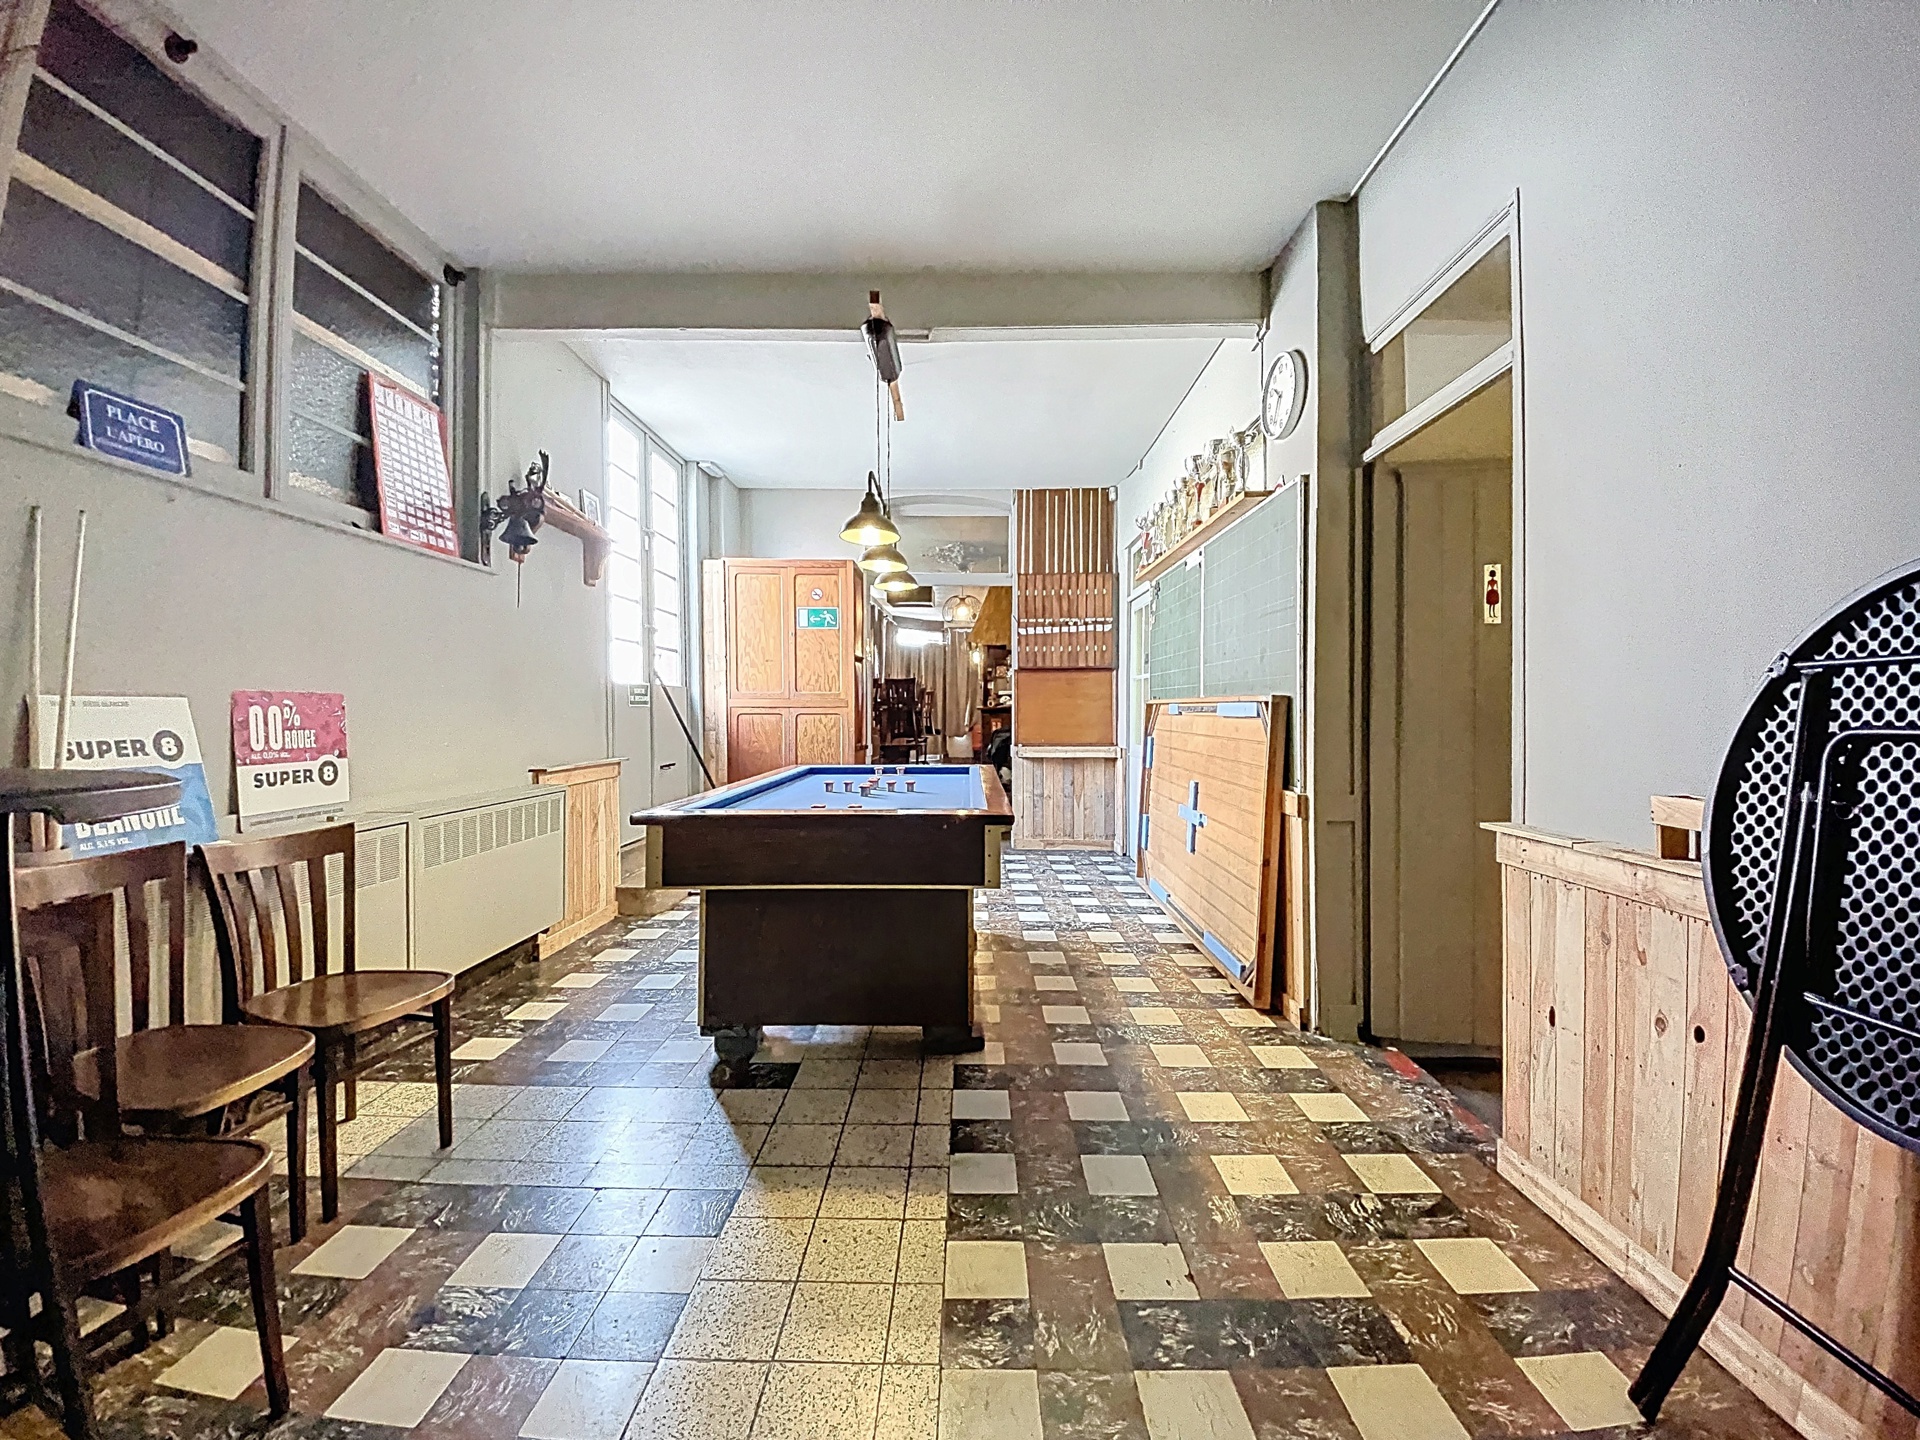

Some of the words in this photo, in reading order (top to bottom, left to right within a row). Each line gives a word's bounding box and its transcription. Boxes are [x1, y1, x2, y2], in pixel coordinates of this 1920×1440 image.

[106, 404, 160, 433] PLACE
[284, 729, 317, 750] ROUGE
[253, 768, 316, 789] SUPER
